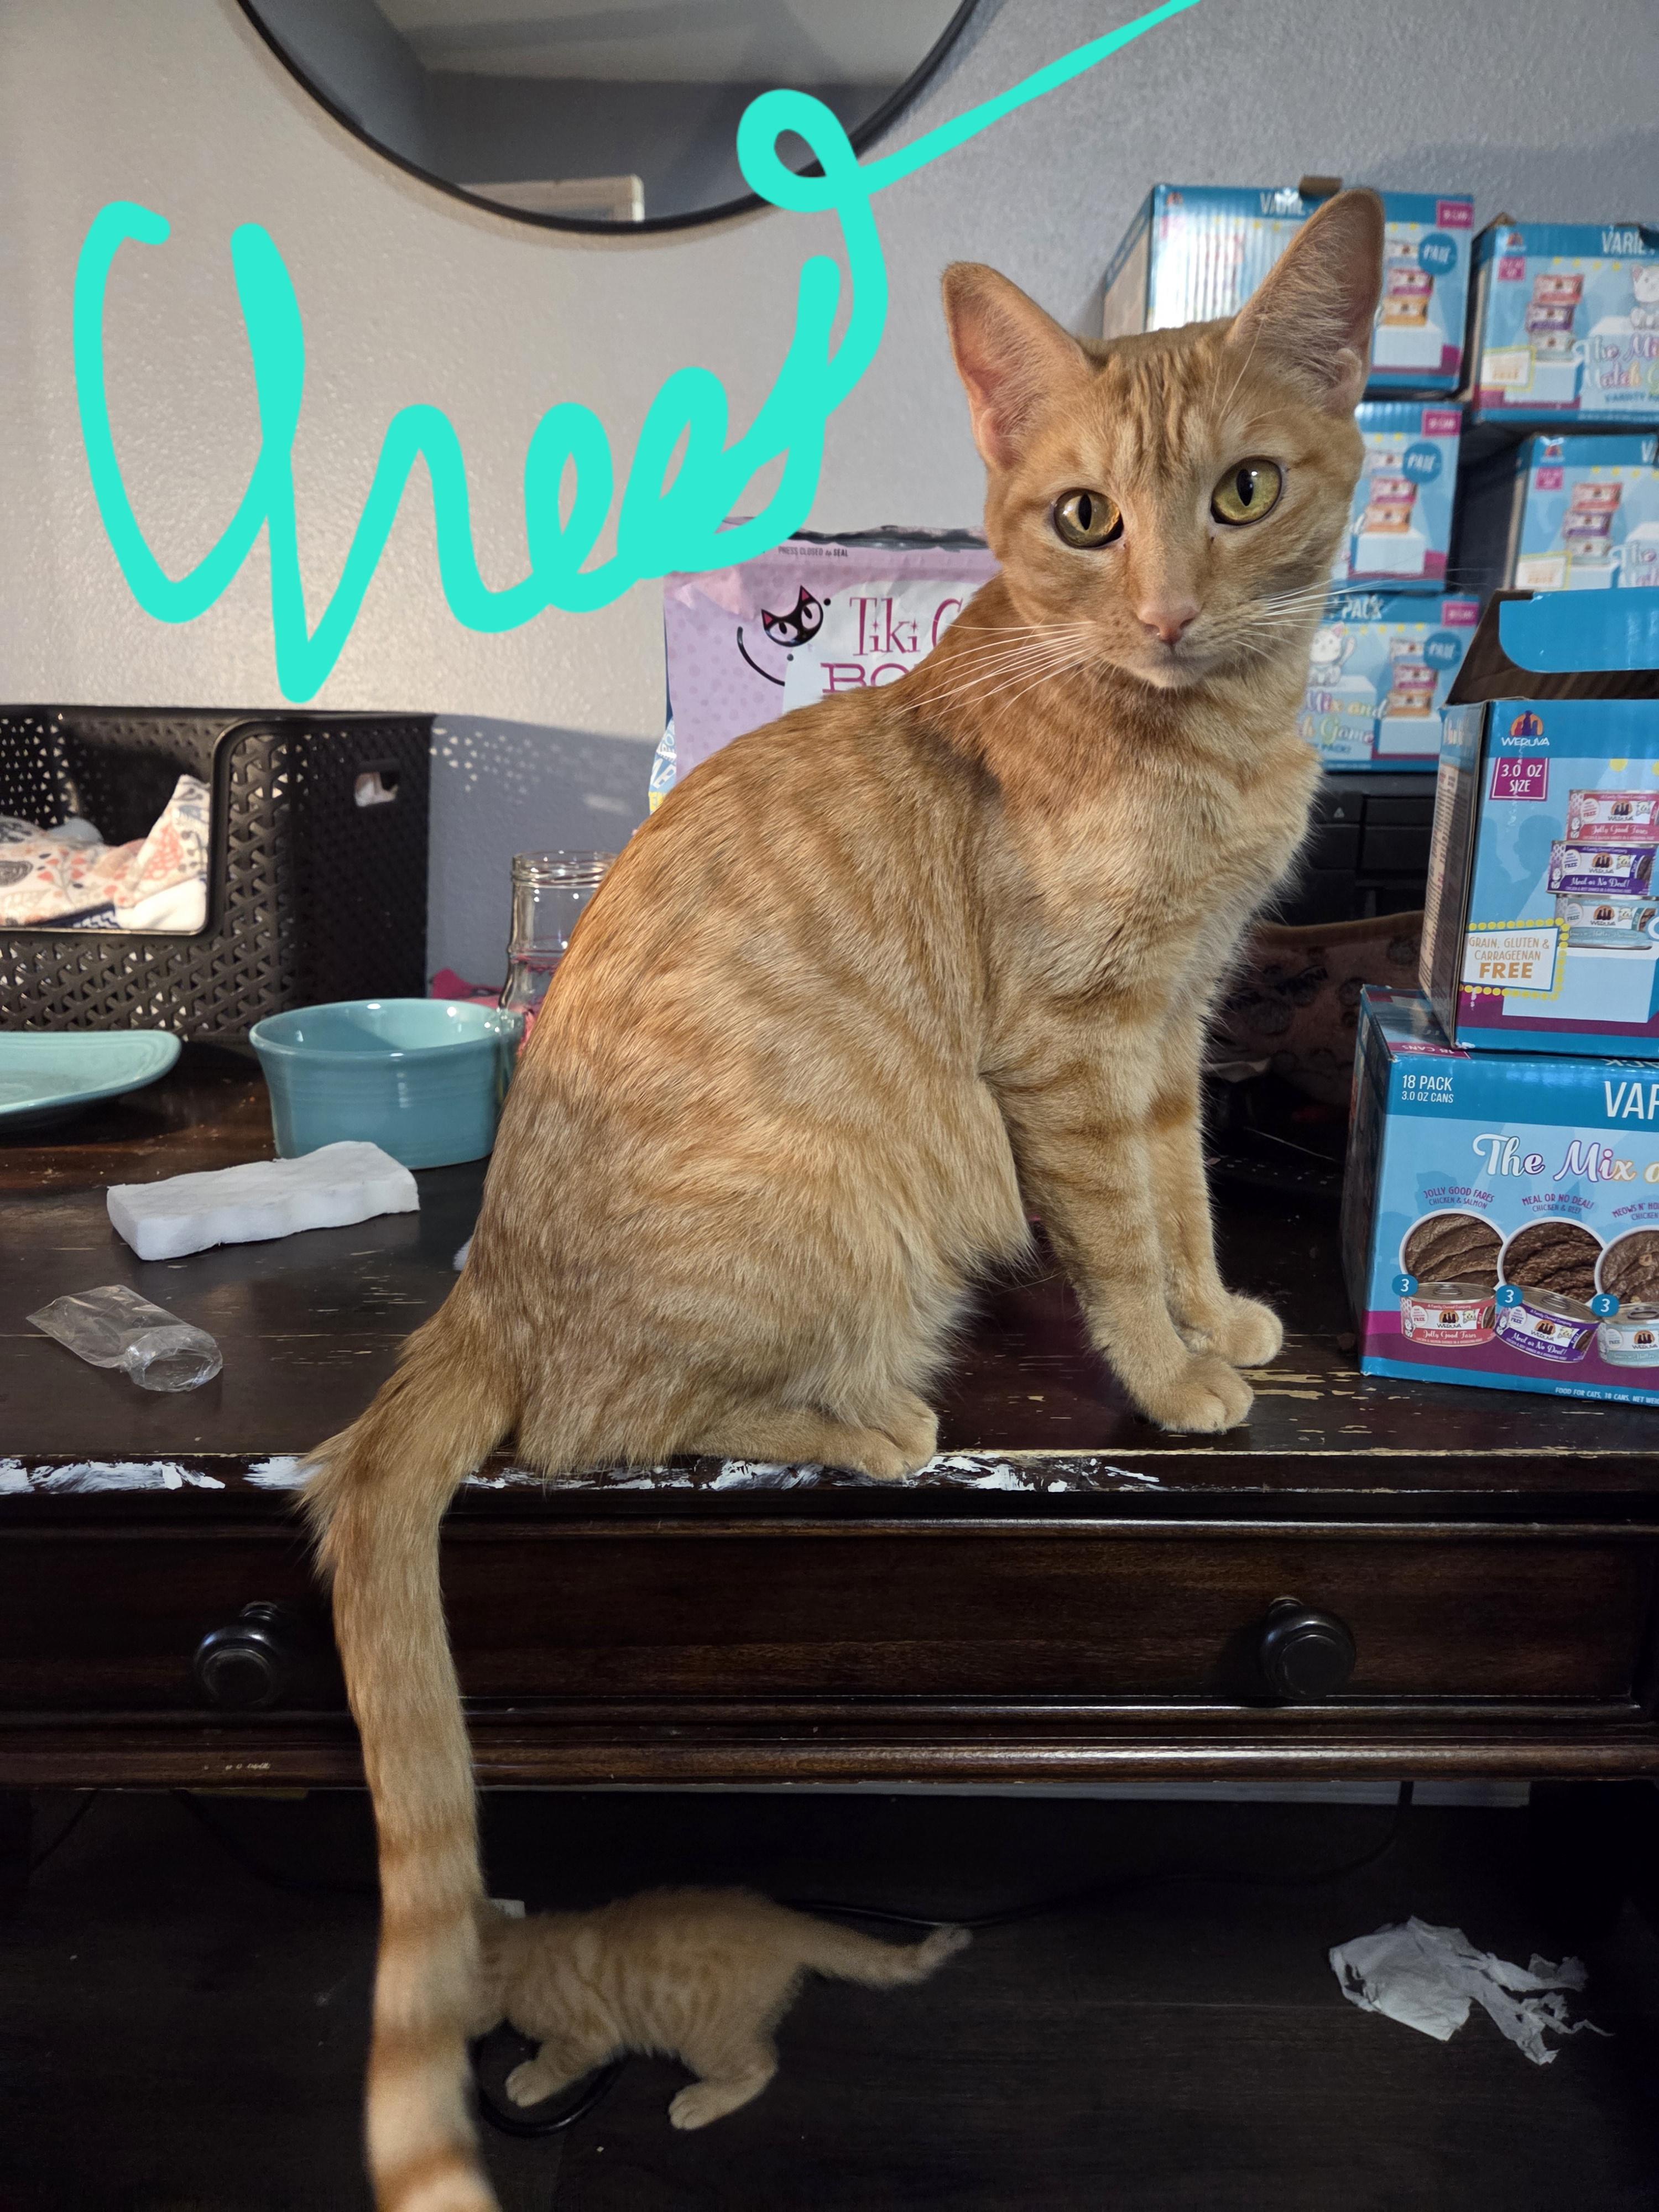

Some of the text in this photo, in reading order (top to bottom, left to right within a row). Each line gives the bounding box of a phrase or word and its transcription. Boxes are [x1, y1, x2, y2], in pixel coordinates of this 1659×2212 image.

[833, 549, 848, 557] SEAL
[849, 597, 920, 656] Tiki
[1501, 737, 1550, 747] WERUVA
[1501, 764, 1543, 778] 3.0 OZ
[1510, 779, 1531, 793] SIZE
[1469, 936, 1550, 950] GRAIN, GLUTEN &
[1474, 950, 1541, 961] CARRAGEENAN
[1479, 962, 1533, 979] FREE
[1402, 1074, 1453, 1092] 18 PACK
[1401, 1091, 1416, 1100] 3.0
[1431, 1092, 1454, 1103] CANS
[1473, 1133, 1546, 1178] The
[1553, 1140, 1637, 1183] Mix
[1423, 1186, 1495, 1203] JOLLY GOOD FARES
[1522, 1194, 1542, 1206] MEAL
[1545, 1193, 1556, 1202] OR
[1558, 1194, 1570, 1203] NO
[1429, 1197, 1454, 1206] CHICKEN
[1463, 1198, 1488, 1209] SALMON
[1612, 1204, 1637, 1218] MEOWS
[1400, 1279, 1410, 1292] 3
[1504, 1289, 1514, 1303] 3
[1600, 1298, 1610, 1312] 3
